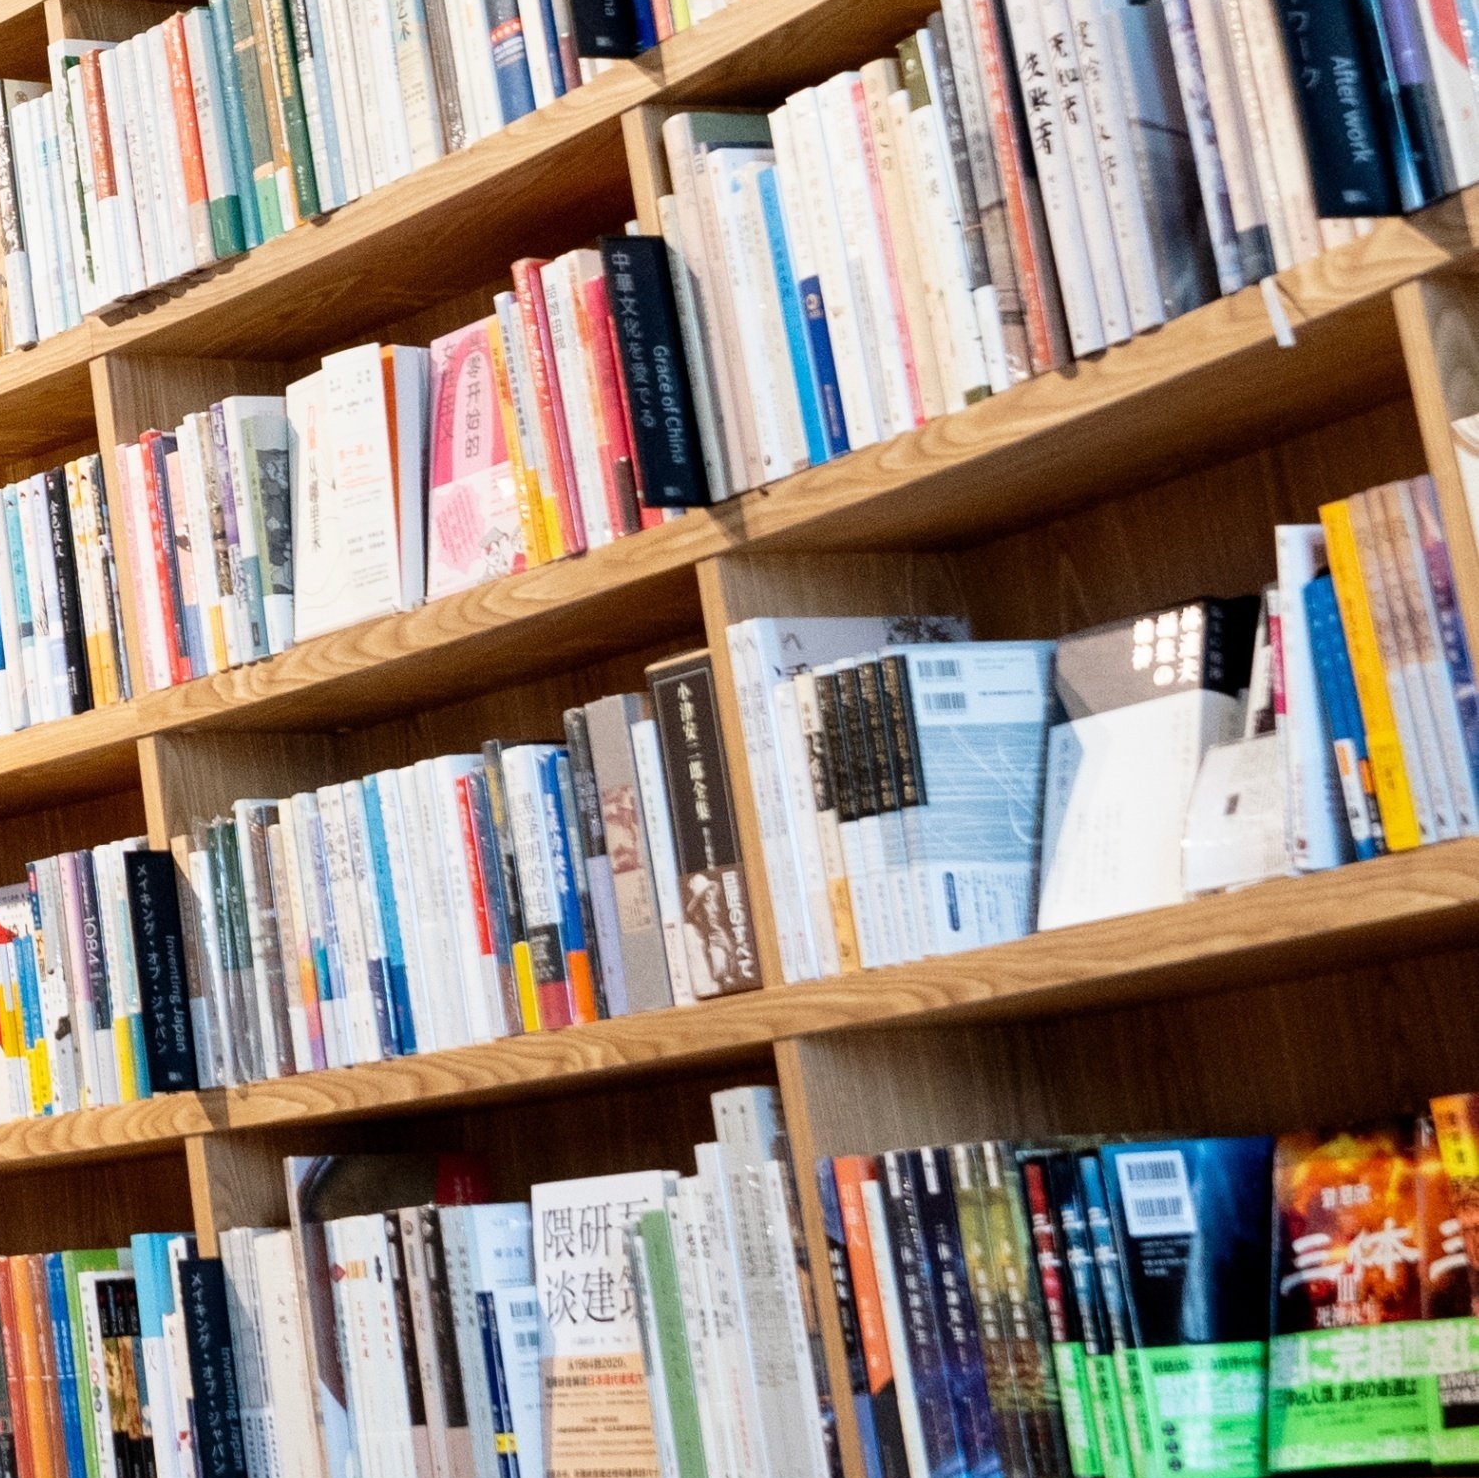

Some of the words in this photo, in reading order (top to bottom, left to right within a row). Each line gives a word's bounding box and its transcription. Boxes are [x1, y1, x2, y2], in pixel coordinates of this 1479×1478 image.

[1328, 54, 1359, 111] After
[1341, 113, 1371, 164] work
[650, 344, 674, 393] Grace
[664, 415, 687, 465] China
[676, 679, 712, 821] 小津安二郎全集
[135, 862, 167, 1056] メイキング・オブ・ジャパン
[165, 934, 184, 1002] Inventing
[173, 1005, 188, 1053] Japan
[1279, 1216, 1424, 1297] 三体
[192, 1269, 227, 1476] メイキング・オブ・ジャパン
[221, 1346, 237, 1421] Inventing
[230, 1422, 245, 1471] Japan
